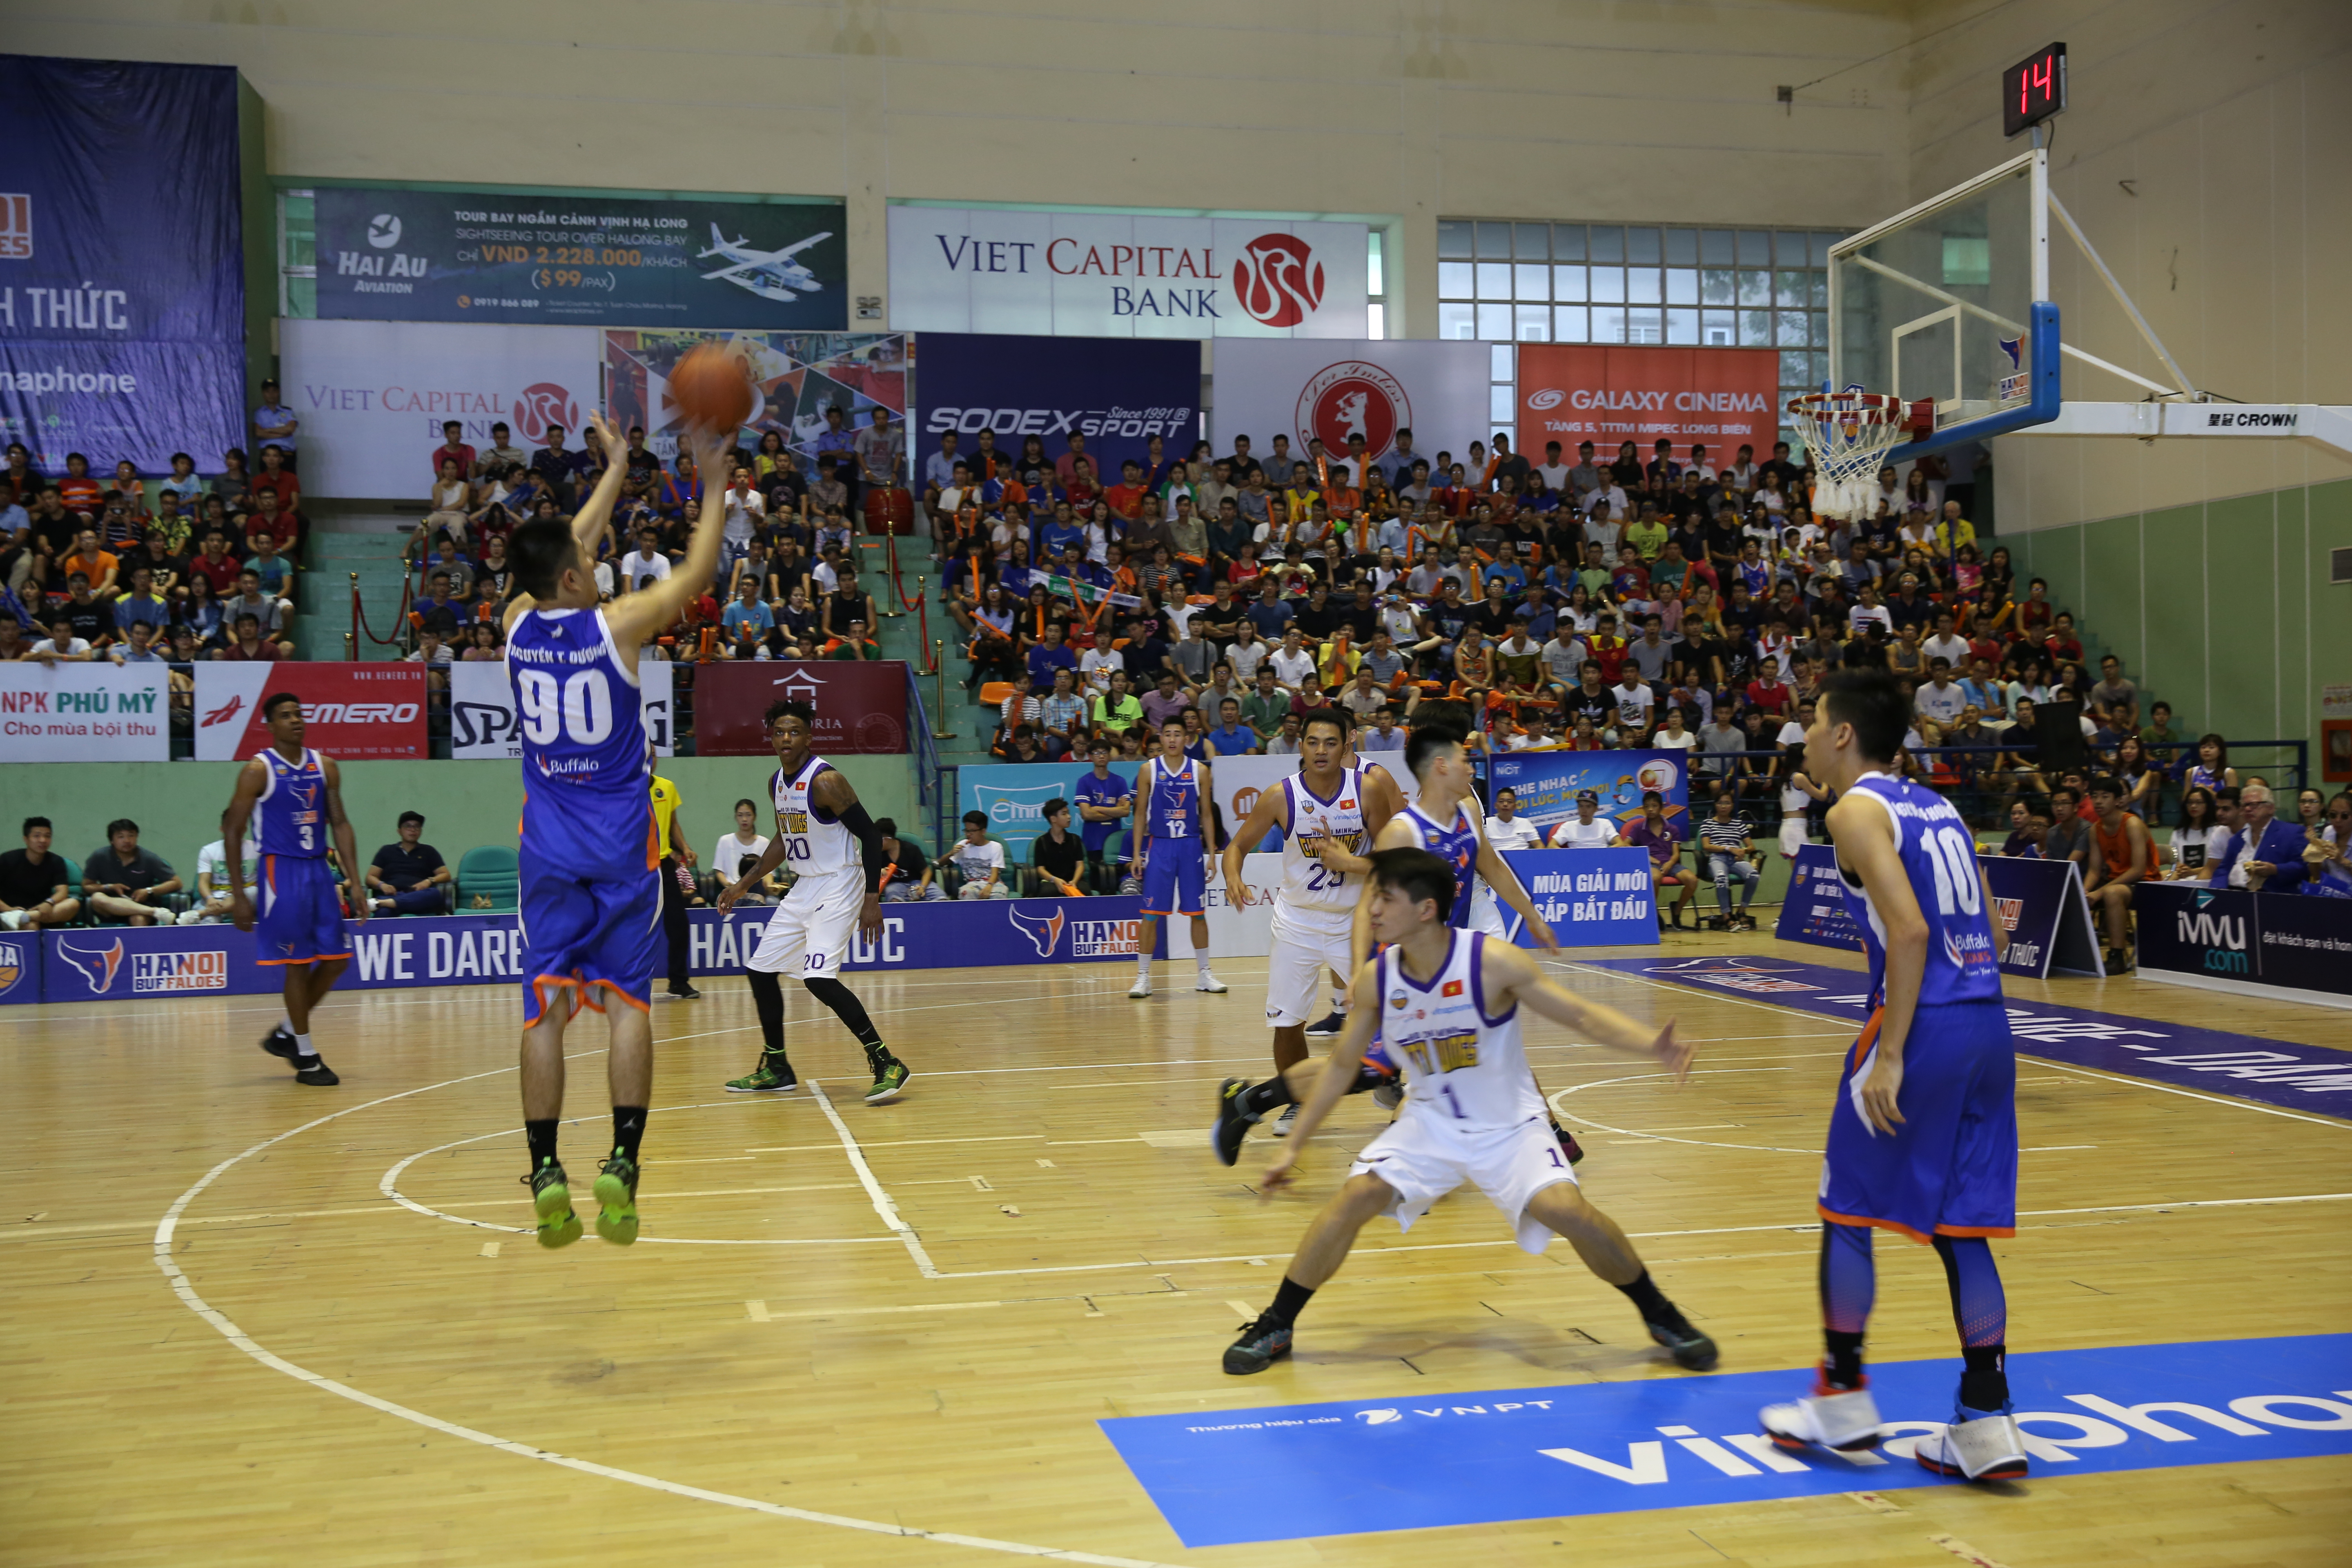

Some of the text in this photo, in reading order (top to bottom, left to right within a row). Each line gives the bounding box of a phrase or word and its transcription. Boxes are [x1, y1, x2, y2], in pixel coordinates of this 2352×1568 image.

[2020, 54, 2051, 114] 14
[454, 211, 487, 223] TOUR
[491, 213, 514, 224] BAY
[654, 218, 688, 229] LONG
[456, 229, 688, 246] SIGHTSEEING TOUR OVER HALONG BAY
[338, 251, 385, 276] HAI
[481, 245, 530, 263] VND
[935, 234, 1222, 280] VIET CAPITAL
[354, 280, 413, 294] AVIATION
[26, 281, 127, 330] THỨC
[1111, 285, 1222, 318] BANK
[0, 366, 136, 396] naphone
[305, 385, 506, 414] VIET CAPITAL
[1570, 389, 1768, 412] GALAXY CINEMA
[926, 407, 1083, 436] SODEX
[1107, 405, 1173, 420] Since 1991
[2238, 413, 2298, 427] CROWN
[1080, 419, 1186, 438] SPORT
[1600, 422, 1635, 433] TTTM
[1638, 423, 1679, 434] MIPEC
[1682, 424, 1718, 435] LONG
[2, 686, 158, 714] NPK PHÚ MỸ
[518, 668, 612, 746] 90
[4, 722, 156, 738] Cho mùa bội thu
[550, 757, 599, 773] Buffalo
[1539, 774, 1579, 791] NHẠC
[299, 825, 314, 851] 3
[1166, 820, 1188, 838] 12
[785, 837, 811, 861] 20
[1532, 867, 1648, 894] MÙA GIẢI MỚI
[1920, 826, 1980, 916] 10
[1534, 894, 1648, 923] SẮP BẮT ĐẦU
[1073, 921, 1141, 941] HANO
[1955, 932, 1990, 952] Buffalo
[354, 933, 414, 981] WE
[428, 929, 524, 978] DARE
[1076, 940, 1140, 955] BUFFALOE
[134, 952, 225, 977] HANOI
[804, 952, 826, 971] 20
[2204, 949, 2248, 974] .com
[136, 976, 225, 991] BUFFALOES
[1442, 1083, 1469, 1119] 1
[1546, 1147, 1565, 1168] 1
[1185, 1421, 1263, 1434] Thương
[1265, 1418, 1305, 1429] hiệu
[1412, 1400, 1555, 1418] VNPT
